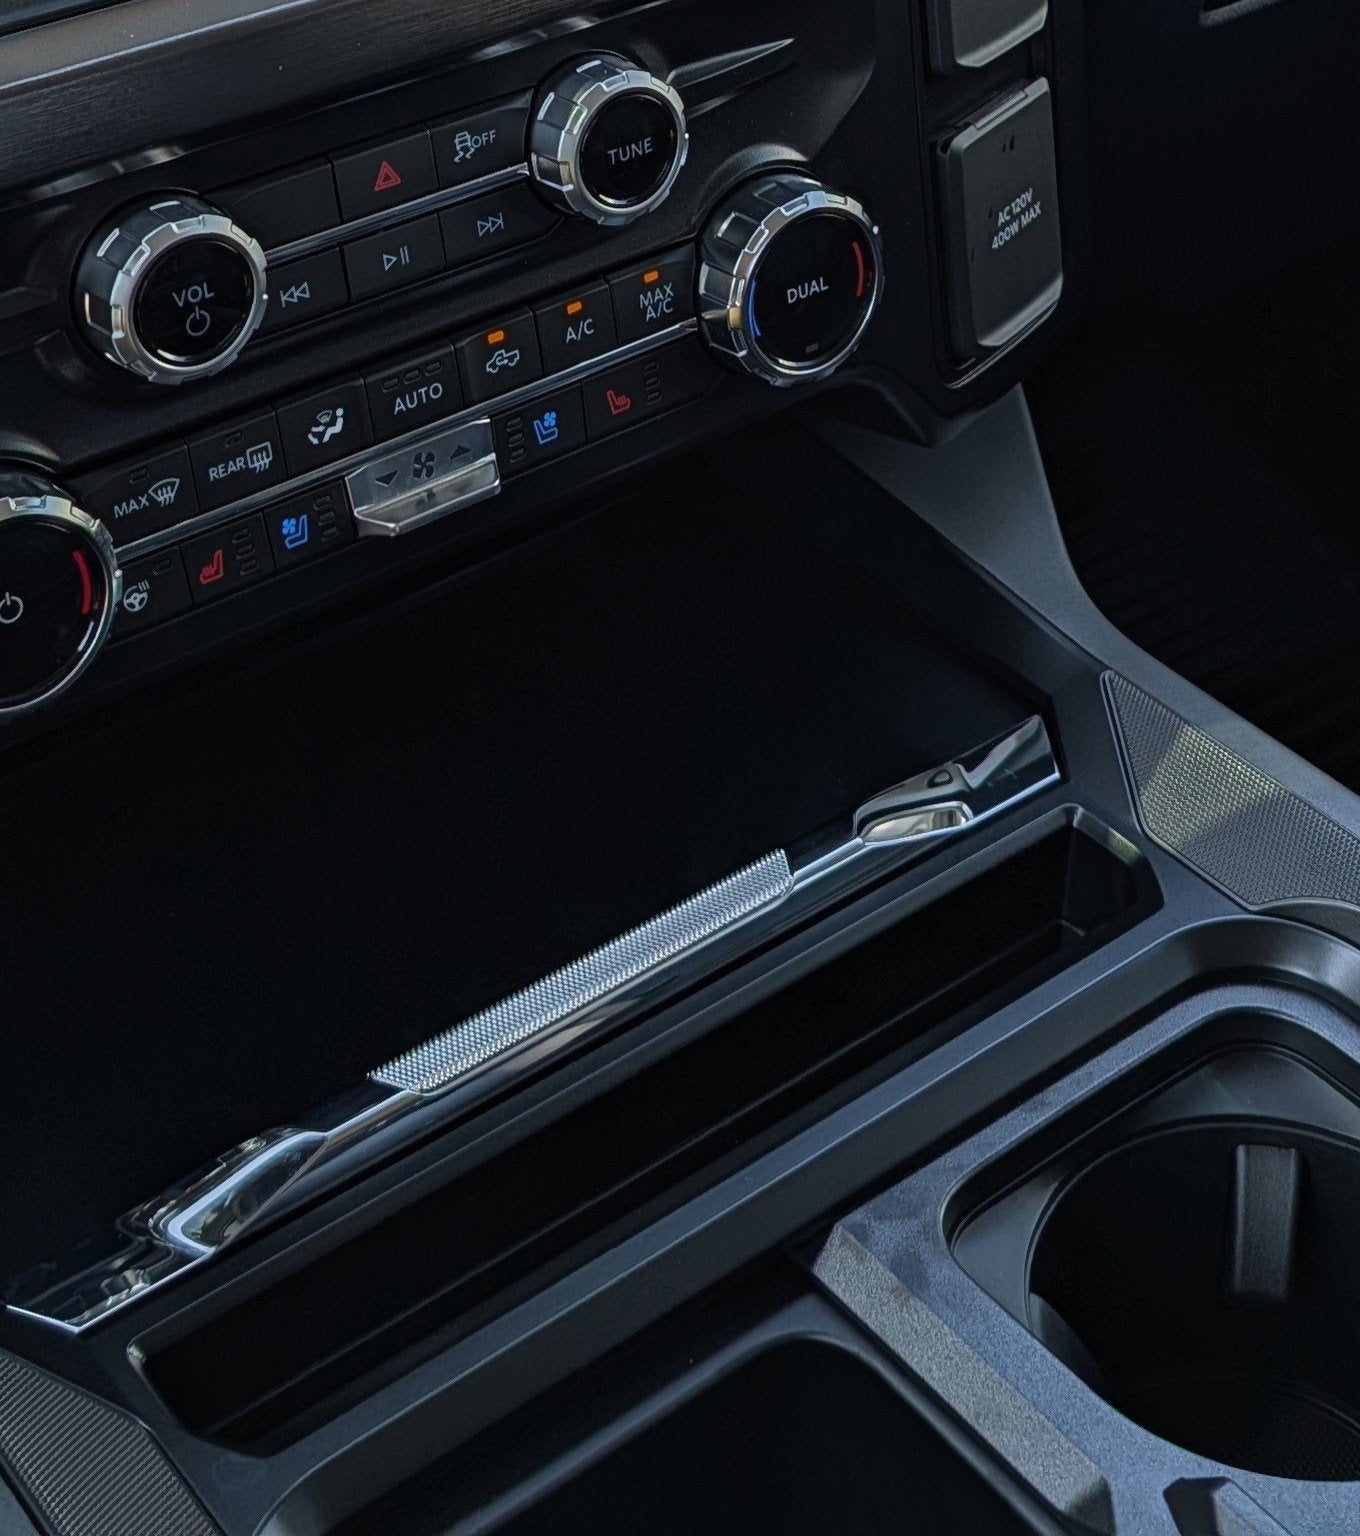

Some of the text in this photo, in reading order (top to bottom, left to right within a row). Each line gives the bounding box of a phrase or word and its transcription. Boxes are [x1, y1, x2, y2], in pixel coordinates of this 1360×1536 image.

[472, 129, 497, 149] OFF
[607, 137, 654, 164] TUNE
[997, 187, 1033, 227] AC 120V
[1021, 200, 1042, 228] MAX
[172, 281, 215, 308] VOL
[639, 282, 675, 309] MAX
[786, 276, 829, 304] DUAL
[645, 298, 674, 322] A/C
[565, 318, 595, 342] A/C
[393, 382, 443, 414] AUTO
[208, 456, 246, 482] REAR
[113, 494, 151, 519] MAX
